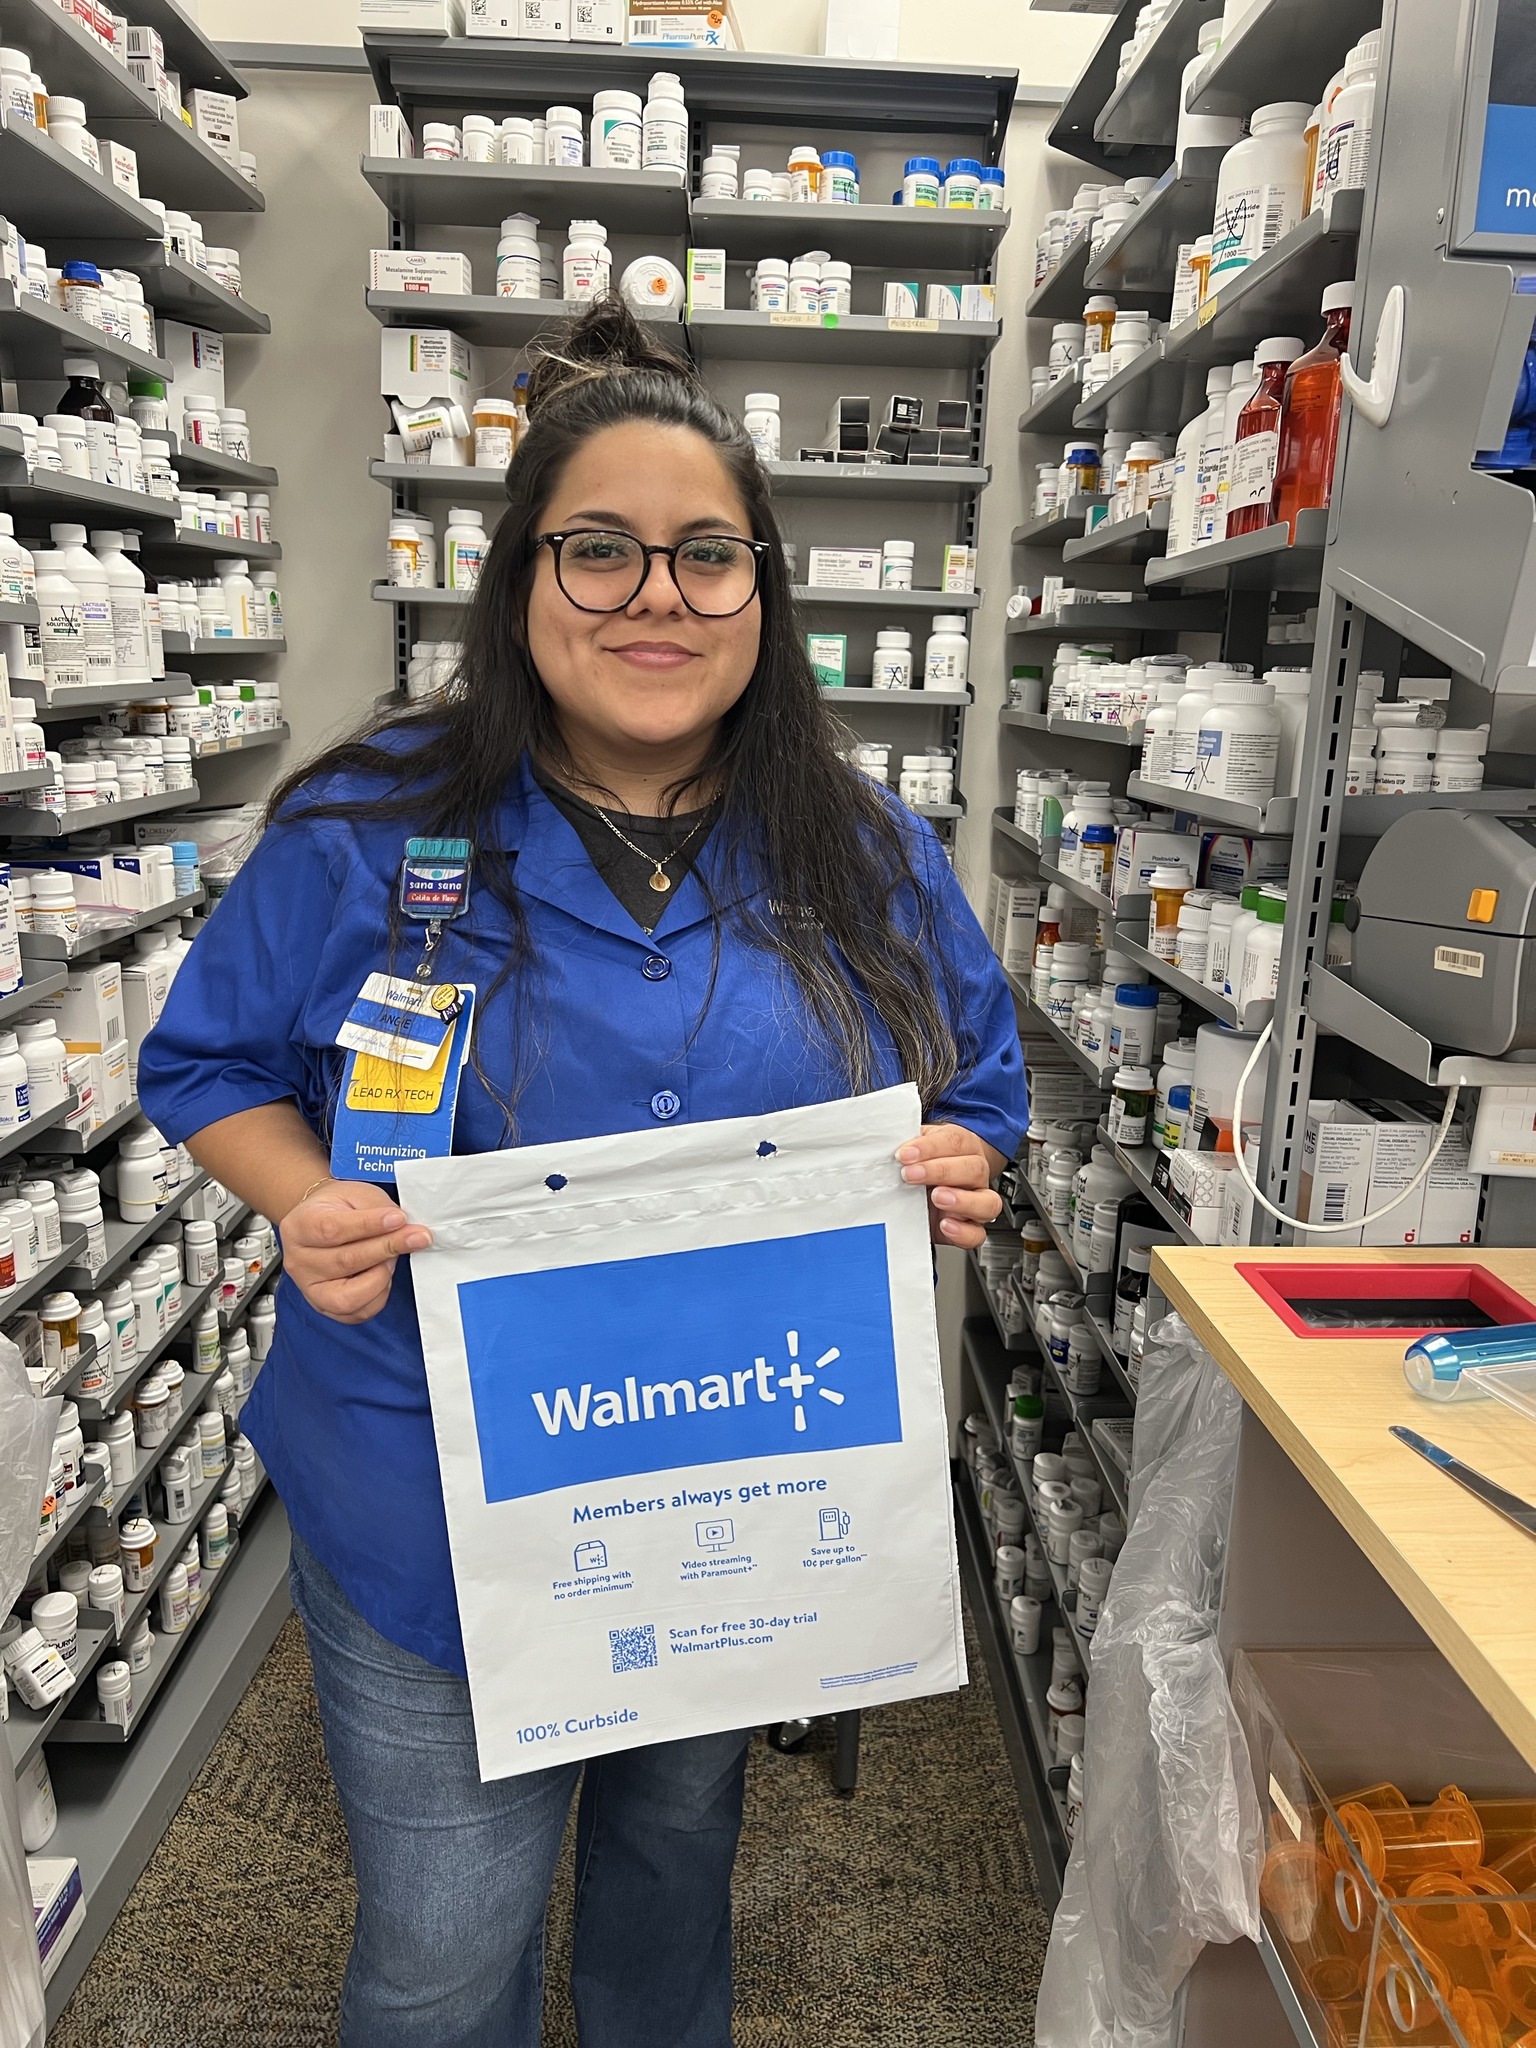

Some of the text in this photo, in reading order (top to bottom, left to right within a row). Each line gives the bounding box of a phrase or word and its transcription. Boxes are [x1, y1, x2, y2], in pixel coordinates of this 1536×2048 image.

[1505, 187, 1536, 208] m
[1224, 249, 1237, 259] 1000
[385, 266, 413, 274] Mesalamine
[409, 274, 423, 282] rectal
[1152, 855, 1175, 863] Paxlovid
[409, 881, 462, 890] sana sana
[386, 990, 423, 1008] Walmart
[379, 1014, 412, 1031] ANGIE
[352, 1087, 435, 1101] LEAD RX TECH
[355, 1141, 427, 1160] Immunizing
[357, 1157, 395, 1173] Techn
[572, 1478, 828, 1524] Members always get more
[811, 1547, 831, 1556] Save
[832, 1547, 844, 1555] up
[681, 1555, 752, 1569] Video streaming
[802, 1559, 818, 1568] 10¢
[819, 1559, 834, 1568] per
[552, 1570, 632, 1590] Free shipping with
[680, 1572, 700, 1581] with
[554, 1592, 566, 1601] no
[567, 1588, 590, 1598] order
[669, 1611, 818, 1639] Scan for free 30-day trial
[670, 1634, 774, 1655] WalmartPlus.com
[516, 1708, 639, 1744] 100% Curbside
